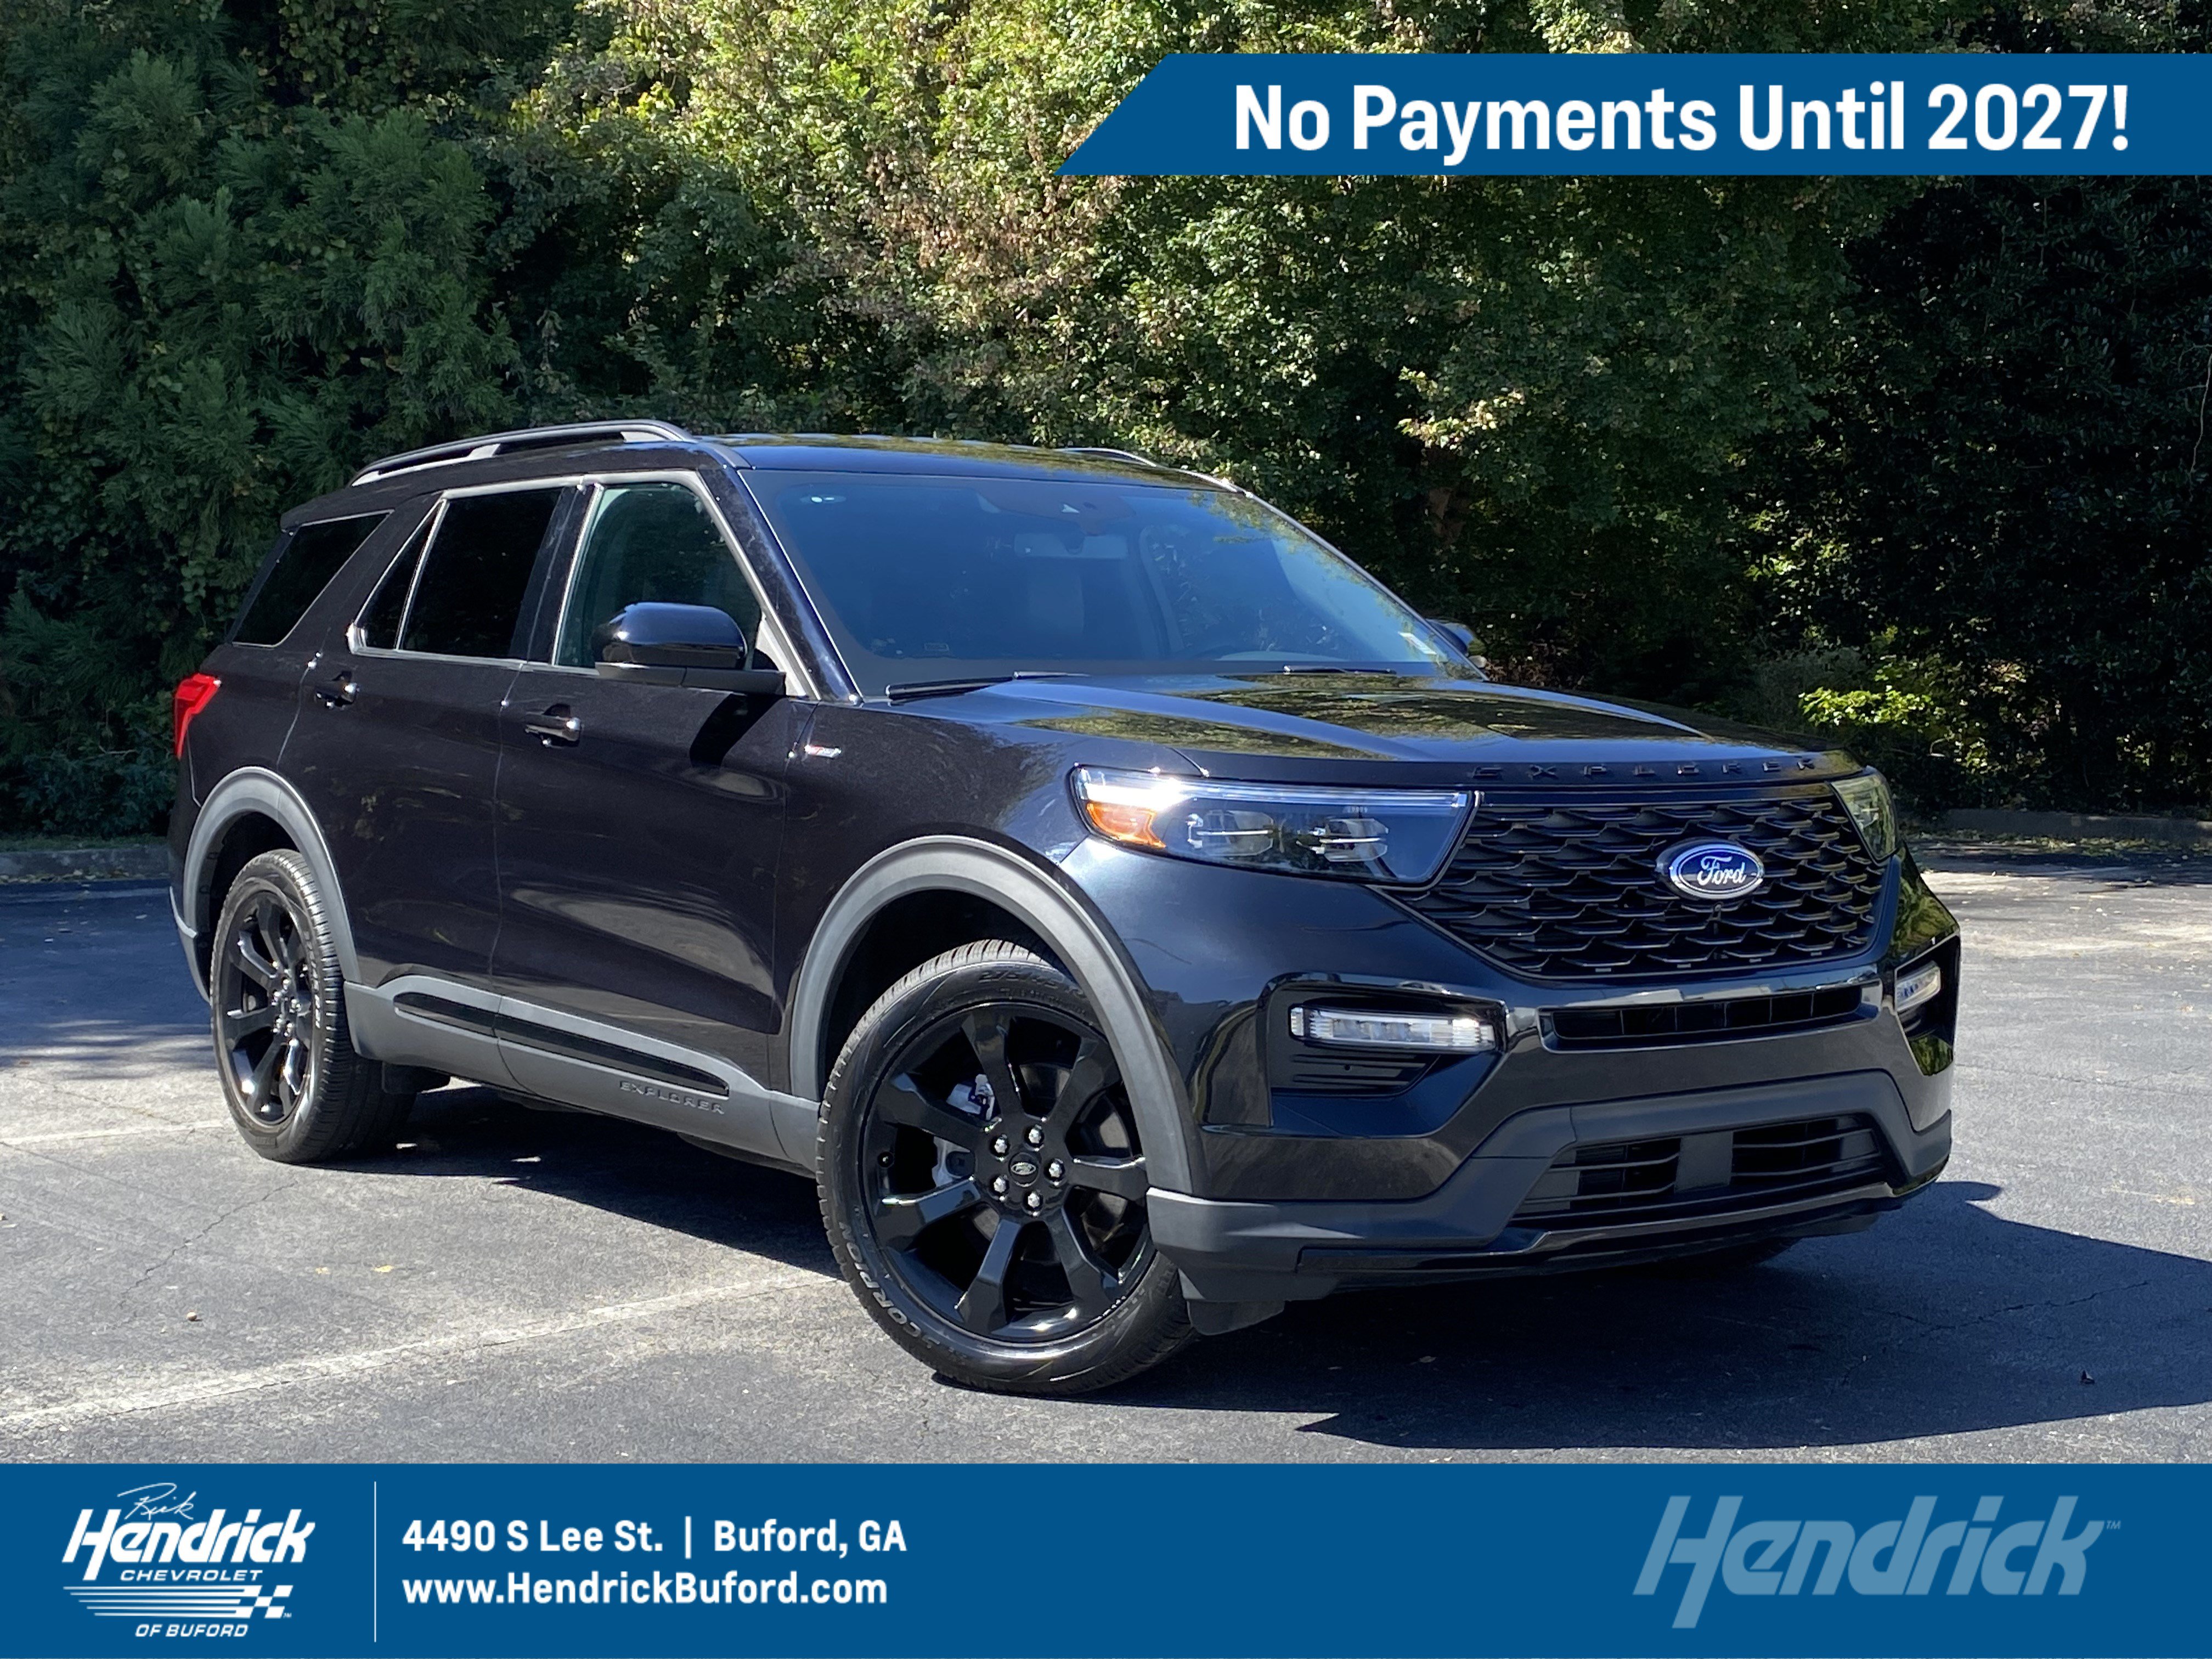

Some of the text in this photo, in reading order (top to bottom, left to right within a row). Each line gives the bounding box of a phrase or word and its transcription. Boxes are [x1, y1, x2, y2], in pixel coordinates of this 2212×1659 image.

[1472, 759, 1815, 779] EXPLORER
[1696, 855, 1747, 886] Ford
[619, 1080, 725, 1115] EXPLORER
[838, 1221, 940, 1349] SCORPION
